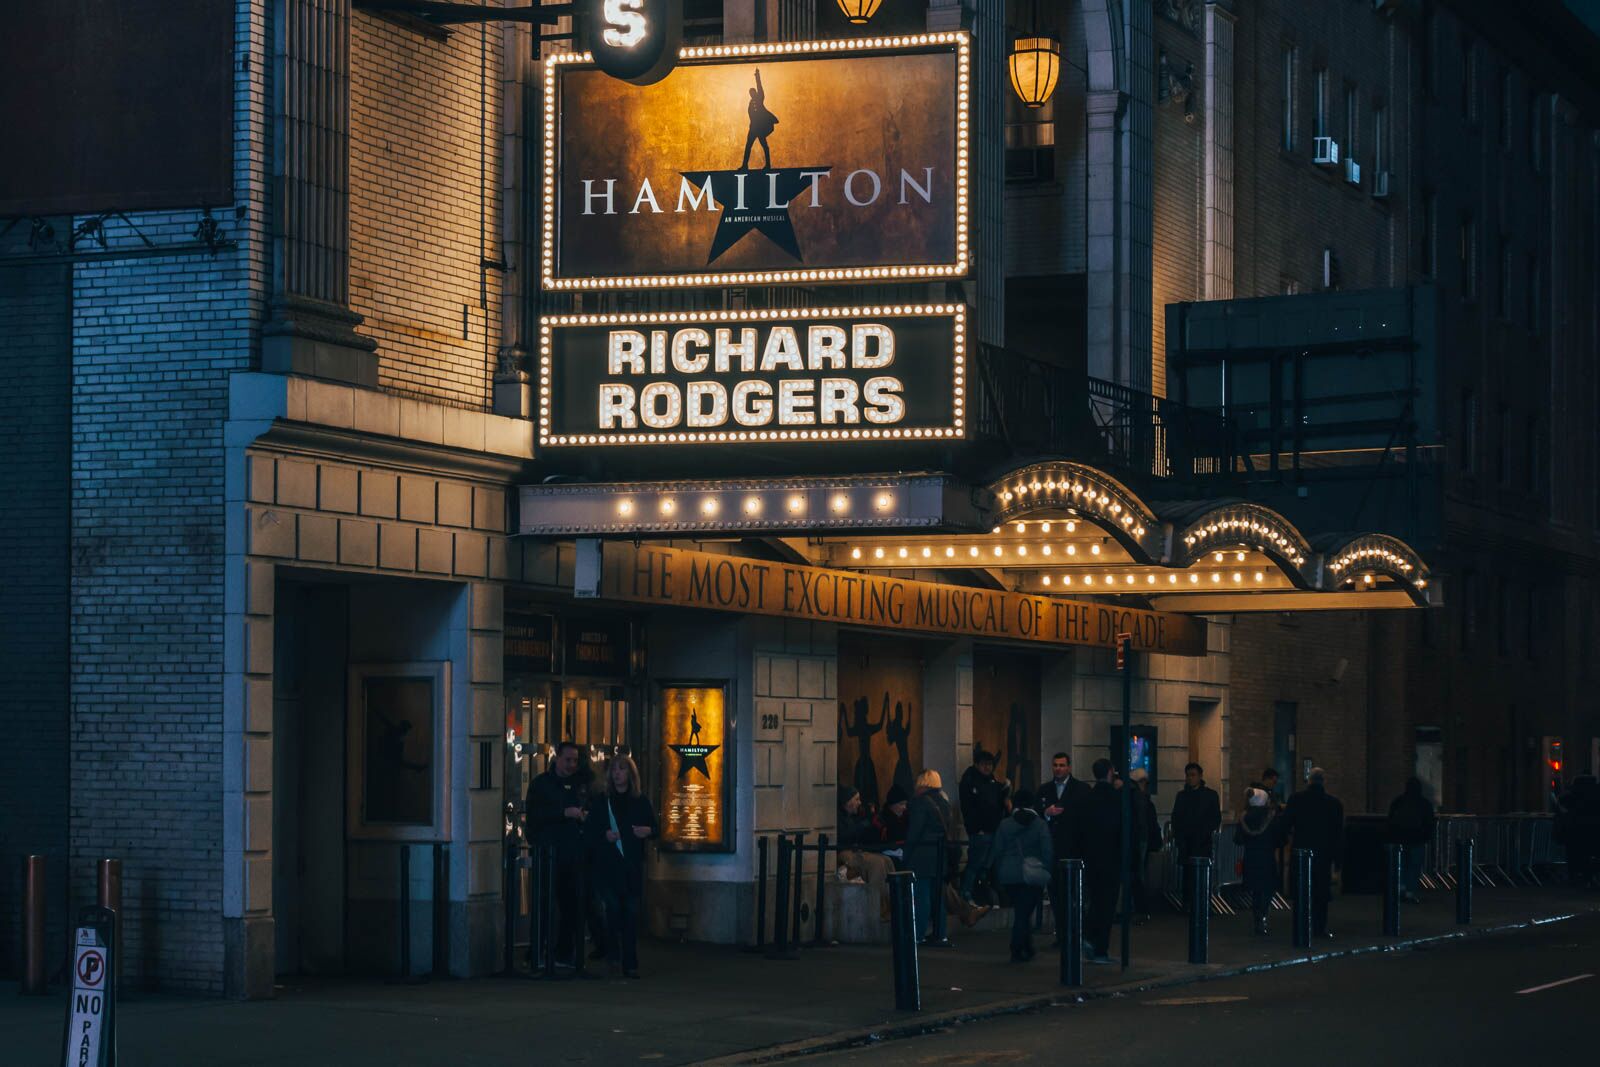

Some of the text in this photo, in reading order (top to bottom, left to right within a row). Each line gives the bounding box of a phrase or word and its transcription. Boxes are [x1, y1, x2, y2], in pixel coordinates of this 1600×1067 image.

[581, 166, 936, 216] HAMILTON
[762, 214, 785, 222] MUSICAL
[608, 323, 896, 375] RICHARD
[598, 376, 906, 430] RODGERS
[688, 556, 770, 609] MOST
[783, 568, 904, 625] EXCITING
[915, 589, 1009, 633] MUSICAL
[1018, 597, 1043, 636] OF
[1052, 602, 1089, 642] THE
[1097, 608, 1167, 650] DECADE
[76, 994, 101, 1016] NO
